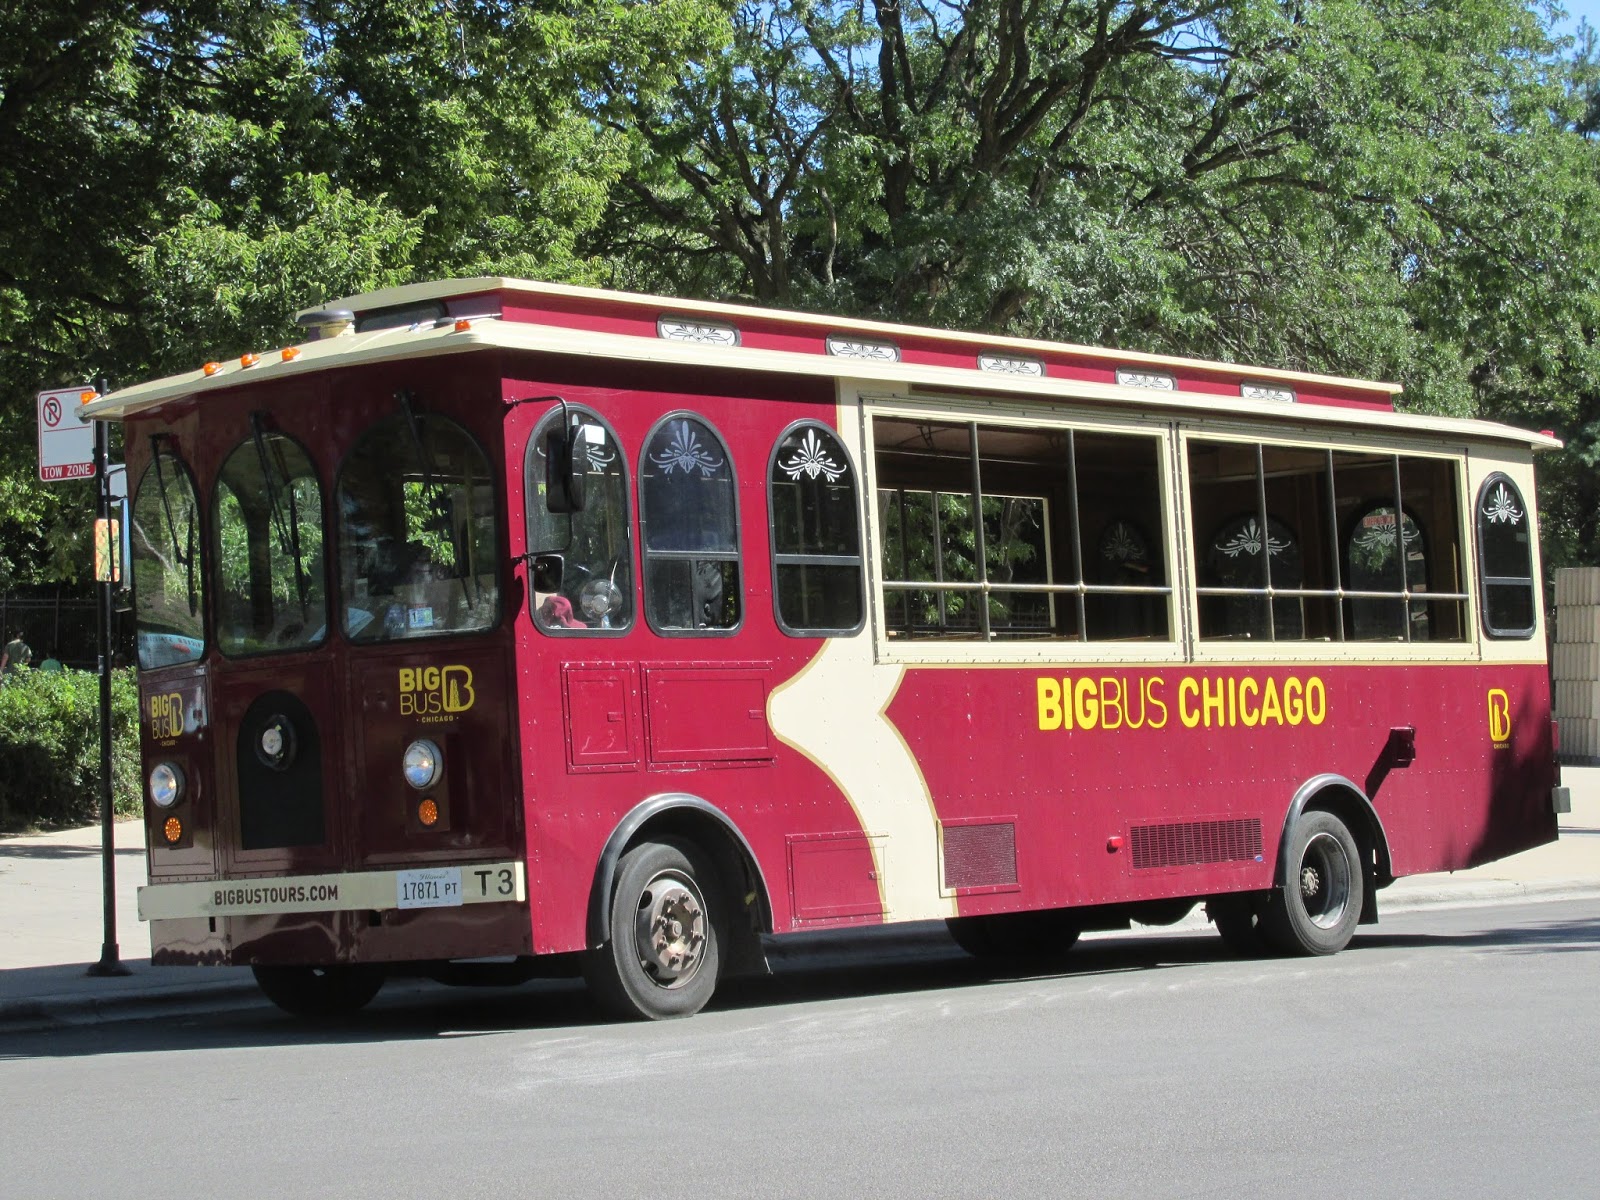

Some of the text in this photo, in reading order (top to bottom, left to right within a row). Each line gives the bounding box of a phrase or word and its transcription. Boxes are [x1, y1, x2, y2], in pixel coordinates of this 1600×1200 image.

[44, 463, 91, 479] TOW ZONE
[399, 666, 440, 692] BIG
[151, 694, 169, 718] BIG
[400, 692, 441, 716] BUS
[1178, 676, 1326, 728] CHICAGO
[151, 717, 170, 740] BUS
[421, 715, 454, 723] CHICAGO
[214, 884, 339, 906] BIGBUSTOURS.COM
[403, 881, 458, 901] 17871 PT
